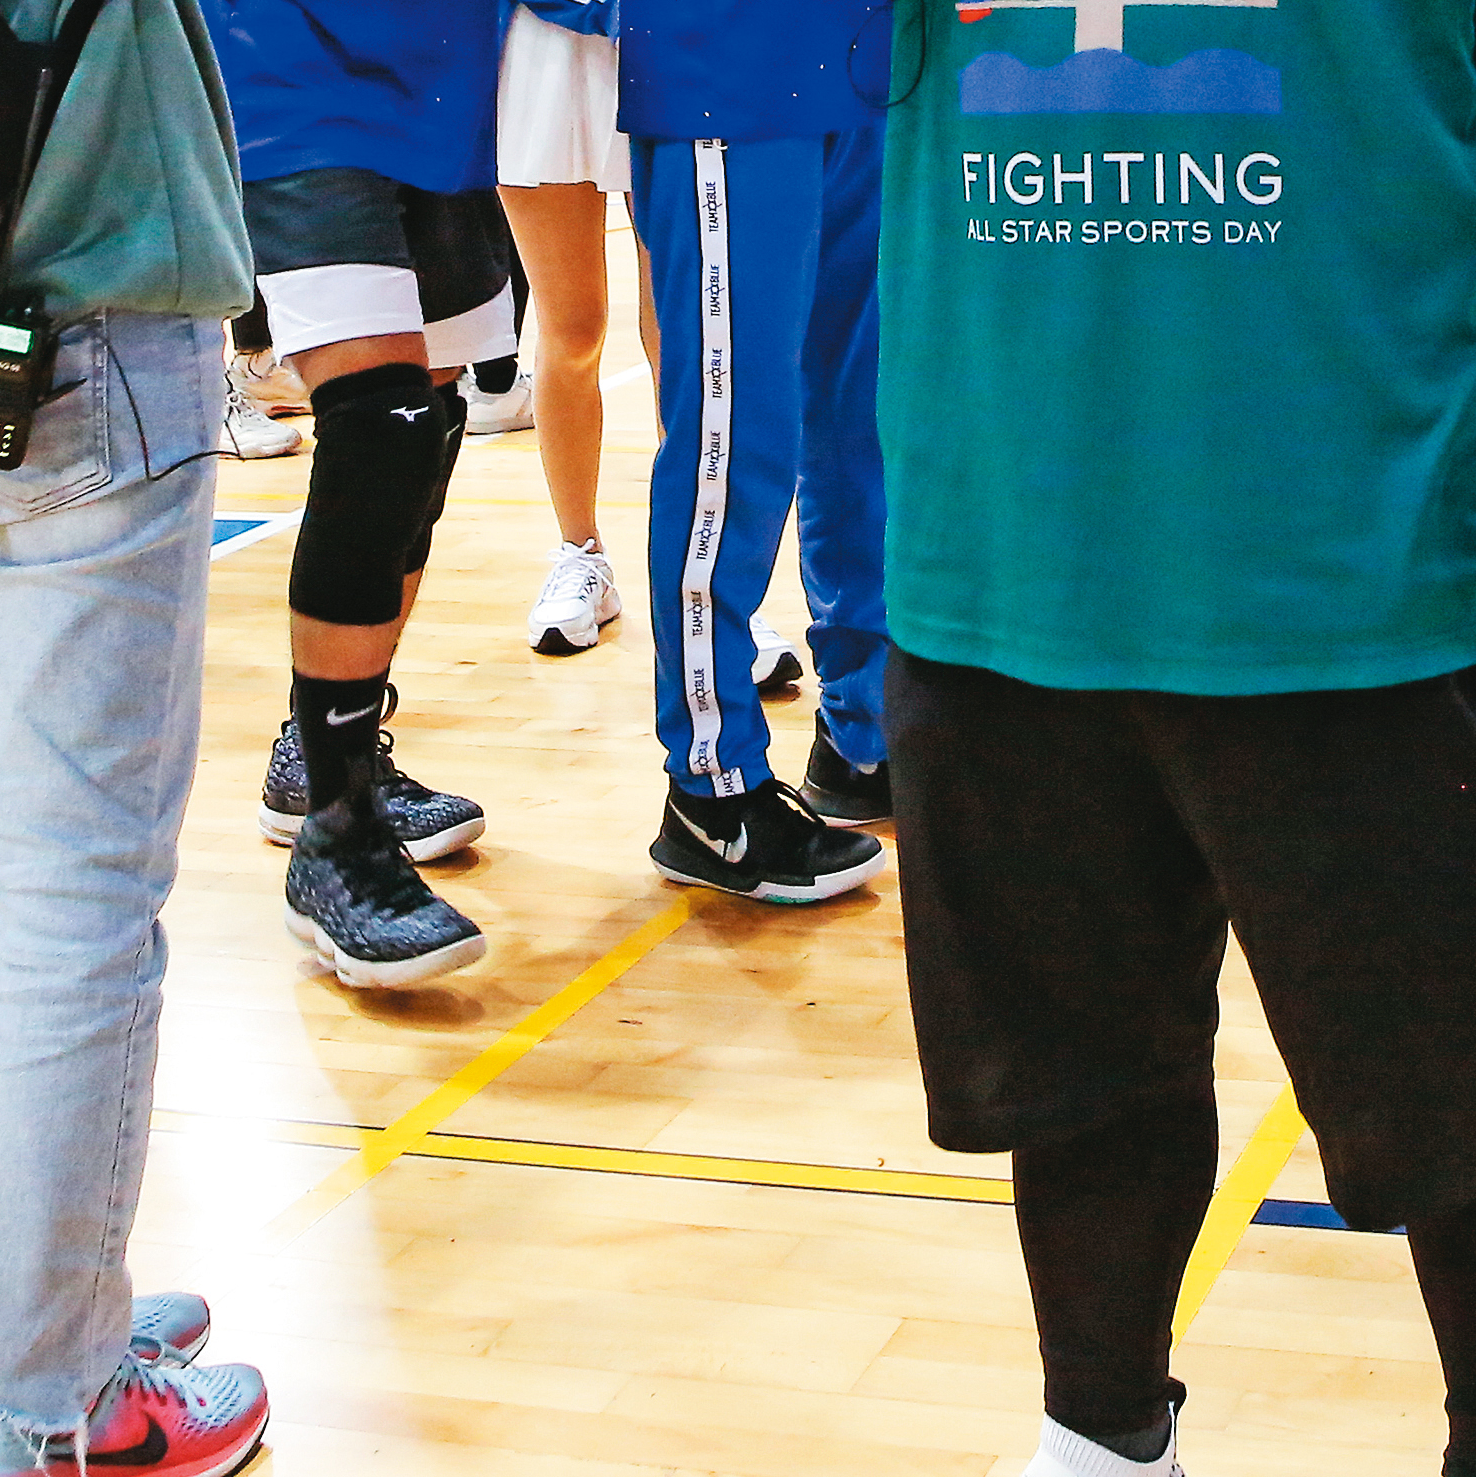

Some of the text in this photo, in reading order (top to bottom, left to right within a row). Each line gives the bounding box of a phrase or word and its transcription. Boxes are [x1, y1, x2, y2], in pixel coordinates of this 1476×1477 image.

[961, 151, 1284, 206] FIGHTING
[968, 218, 1283, 244] ALL STAR SPORTS DAY
